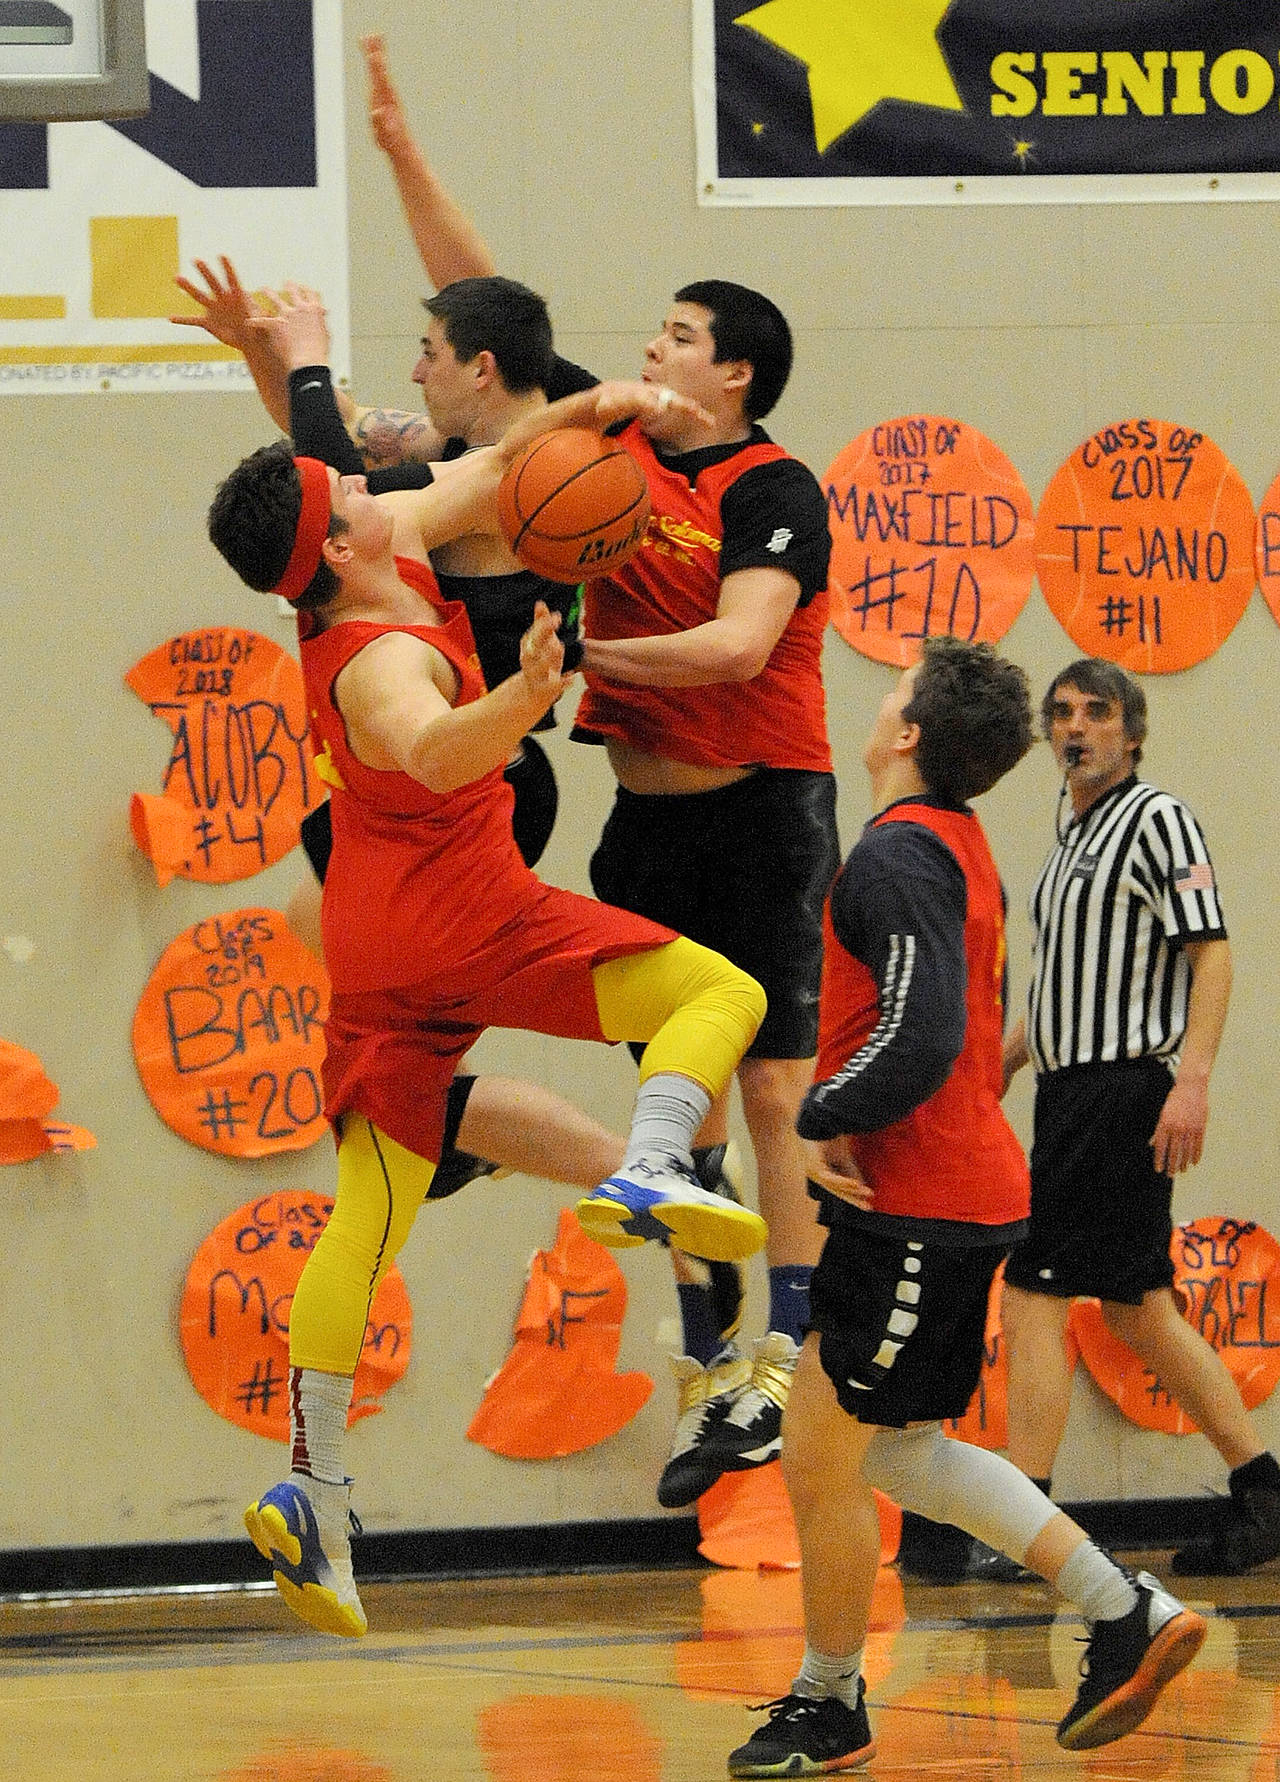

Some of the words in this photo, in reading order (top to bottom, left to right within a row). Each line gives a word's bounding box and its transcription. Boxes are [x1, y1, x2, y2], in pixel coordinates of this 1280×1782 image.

[989, 48, 1280, 118] SENIO
[879, 461, 932, 486] 2017
[1109, 454, 1194, 501] 2017
[827, 484, 1019, 550] MAXFIELD
[1056, 524, 1228, 583] TEJANO
[848, 555, 982, 641] #10
[1098, 594, 1162, 644] #11
[175, 668, 235, 697] 2018
[197, 1067, 322, 1140] #20
[252, 1198, 335, 1227] Clas
